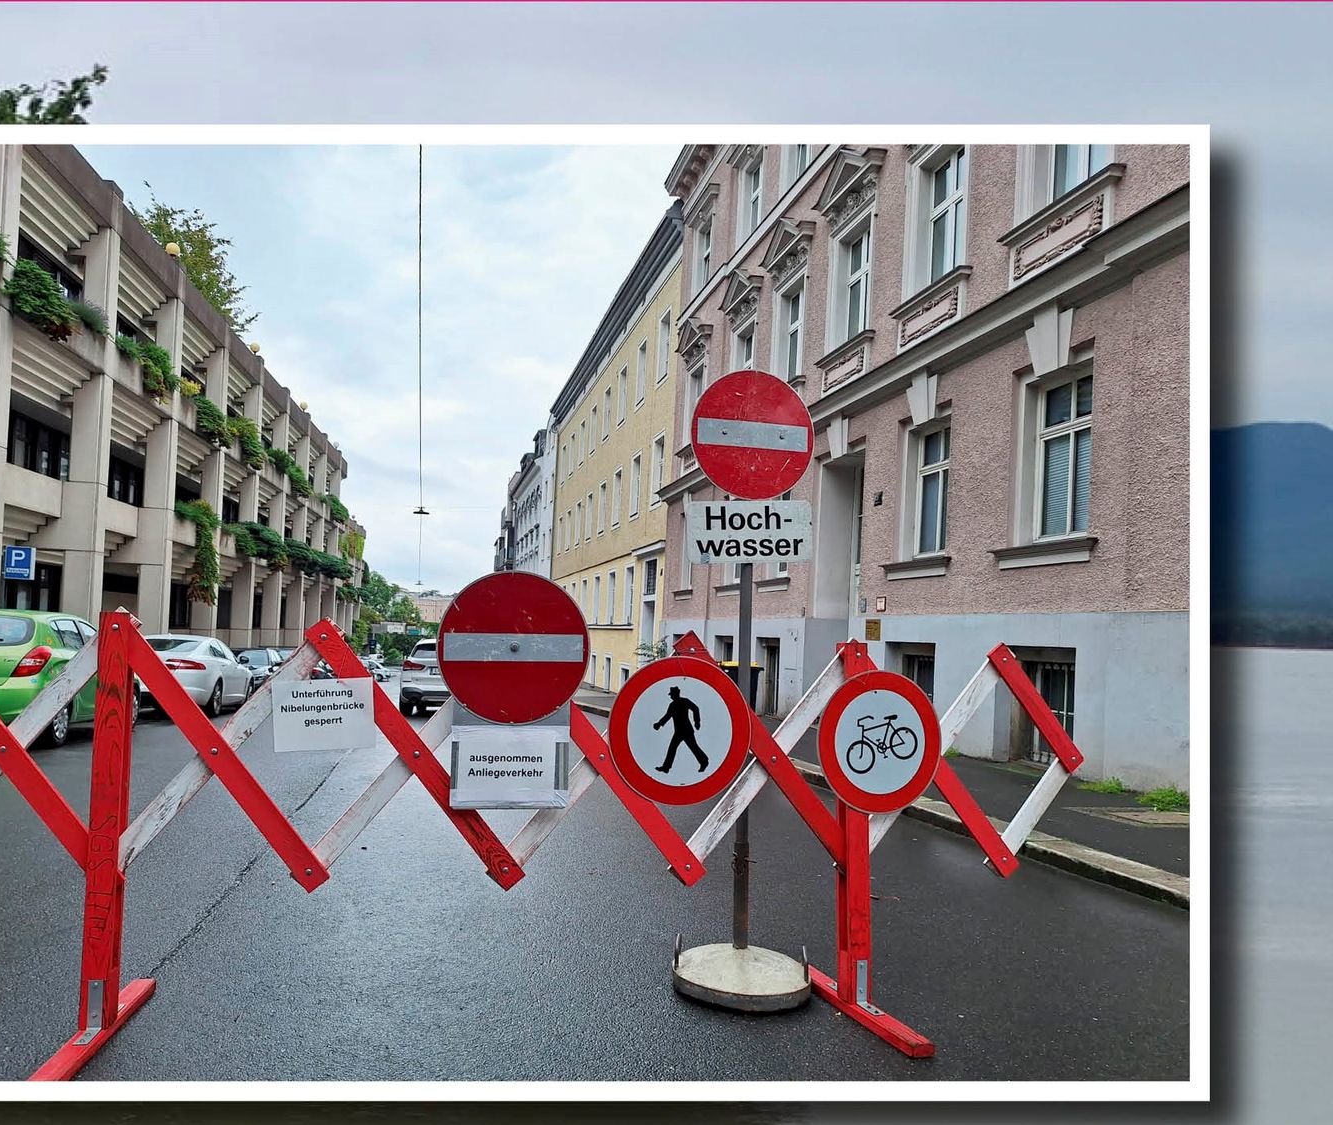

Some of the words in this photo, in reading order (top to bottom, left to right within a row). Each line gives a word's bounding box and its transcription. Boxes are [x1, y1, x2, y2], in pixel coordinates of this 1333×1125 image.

[705, 505, 793, 531] Hoch-
[696, 538, 804, 557] wasser
[11, 550, 26, 567] P
[291, 689, 353, 699] Unterführung
[280, 701, 365, 713] Nibelungenbrücke
[304, 716, 343, 727] gesperrt
[469, 754, 543, 764] ausgenommen
[468, 768, 544, 779] Anliegeverkehr
